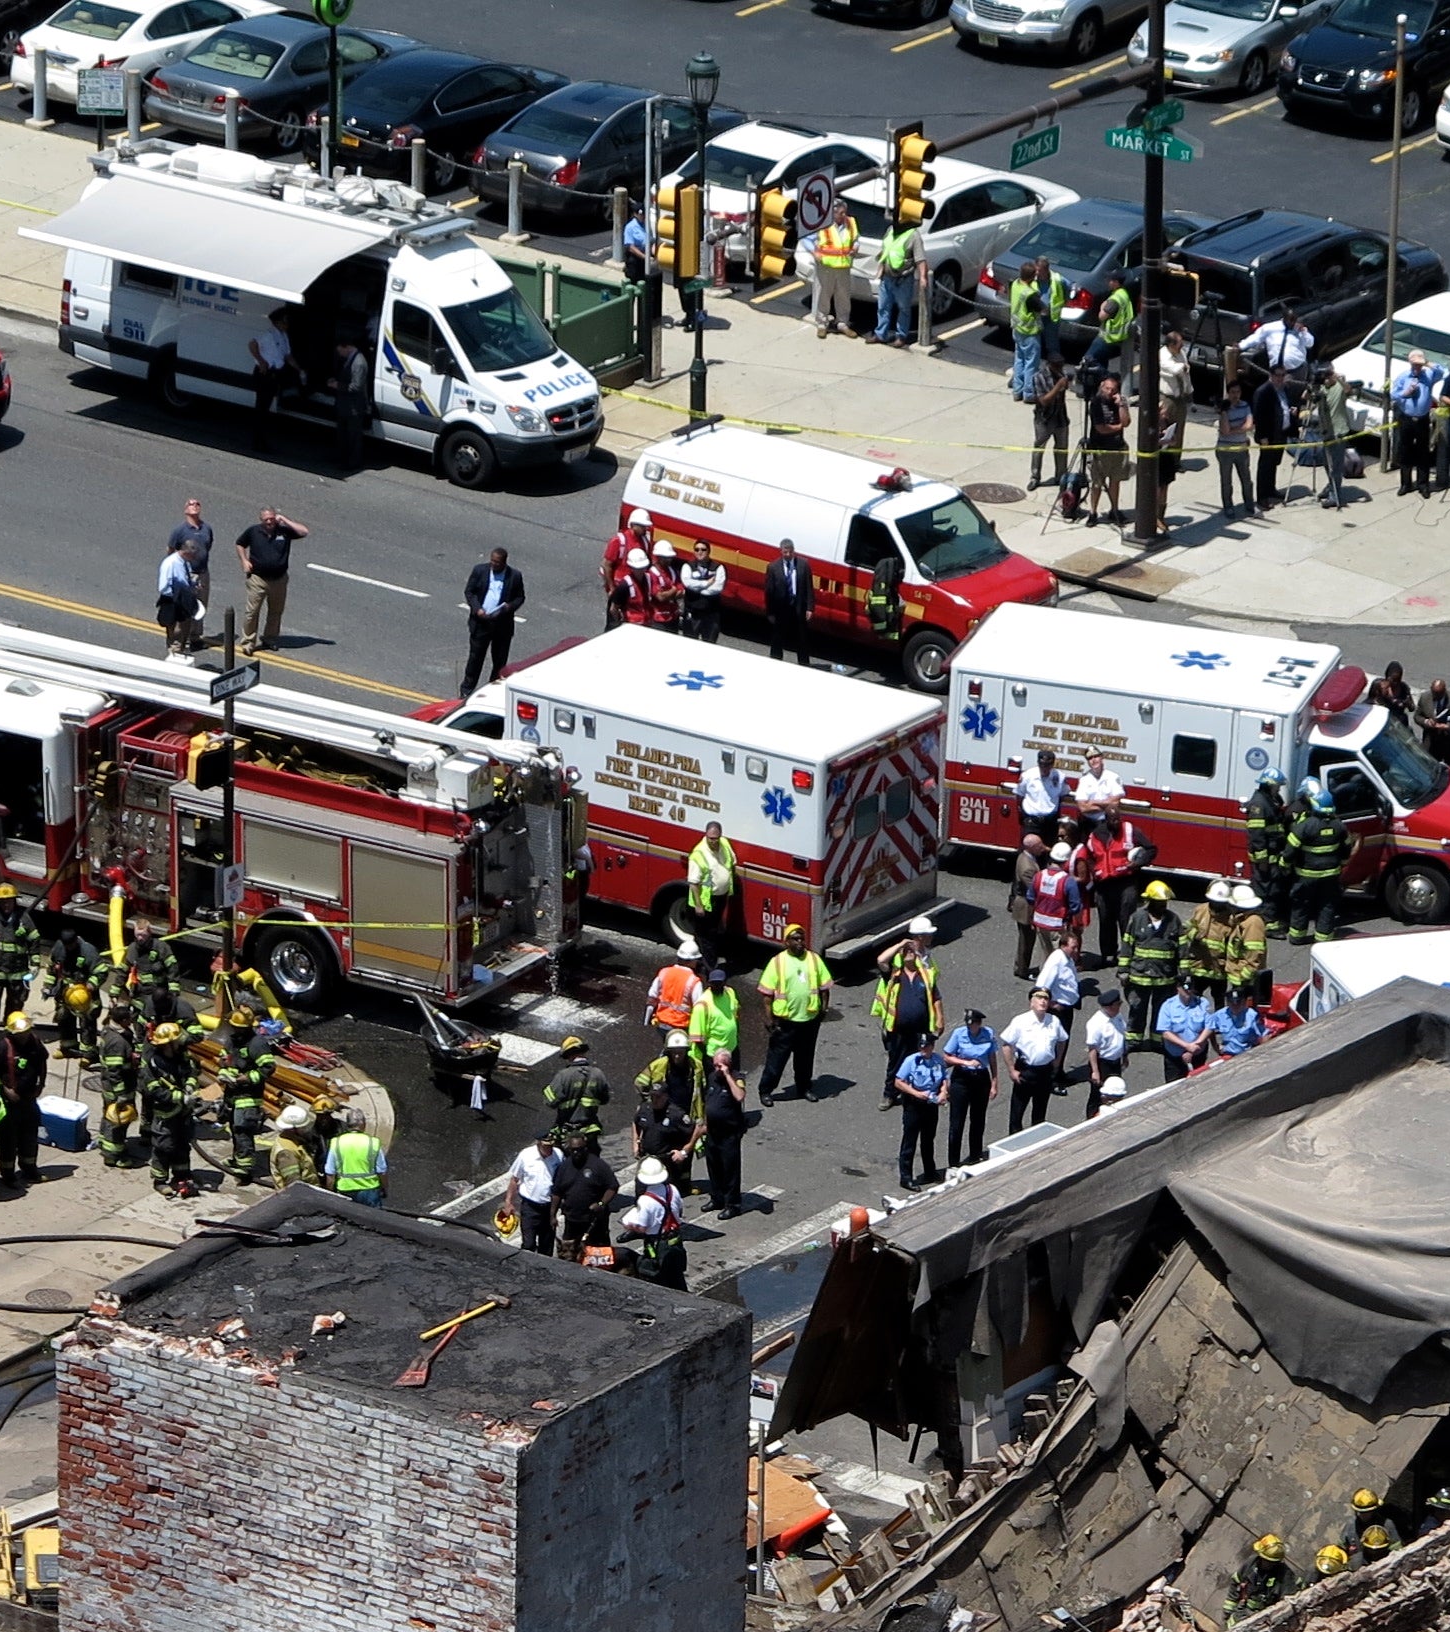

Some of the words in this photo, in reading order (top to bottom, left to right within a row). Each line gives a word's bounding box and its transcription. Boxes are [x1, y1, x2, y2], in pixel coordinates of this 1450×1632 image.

[1015, 140, 1041, 164] 22nd
[1043, 134, 1054, 152] St
[1112, 132, 1169, 157] MARKET
[1180, 150, 1190, 161] ST
[123, 318, 143, 329] DIAL
[123, 327, 145, 342] 911
[523, 372, 592, 403] POLICE
[1043, 709, 1120, 731] PHILADELPHIA
[1033, 725, 1058, 740] FIRE
[1061, 728, 1129, 749] DEPARTMENT
[616, 739, 702, 775] PHILADELPHIA
[606, 755, 633, 777] FIRE
[638, 763, 711, 795] DEPARTMENT
[594, 771, 642, 793] EMERGENCY
[645, 784, 679, 803] MEDICAL
[682, 793, 720, 813] SERVICES
[959, 796, 989, 810] DIAL
[628, 794, 663, 816] MEDIC
[668, 805, 686, 822] 40
[959, 808, 990, 825] 911
[762, 912, 788, 926] DIAL
[762, 923, 782, 940] 91
